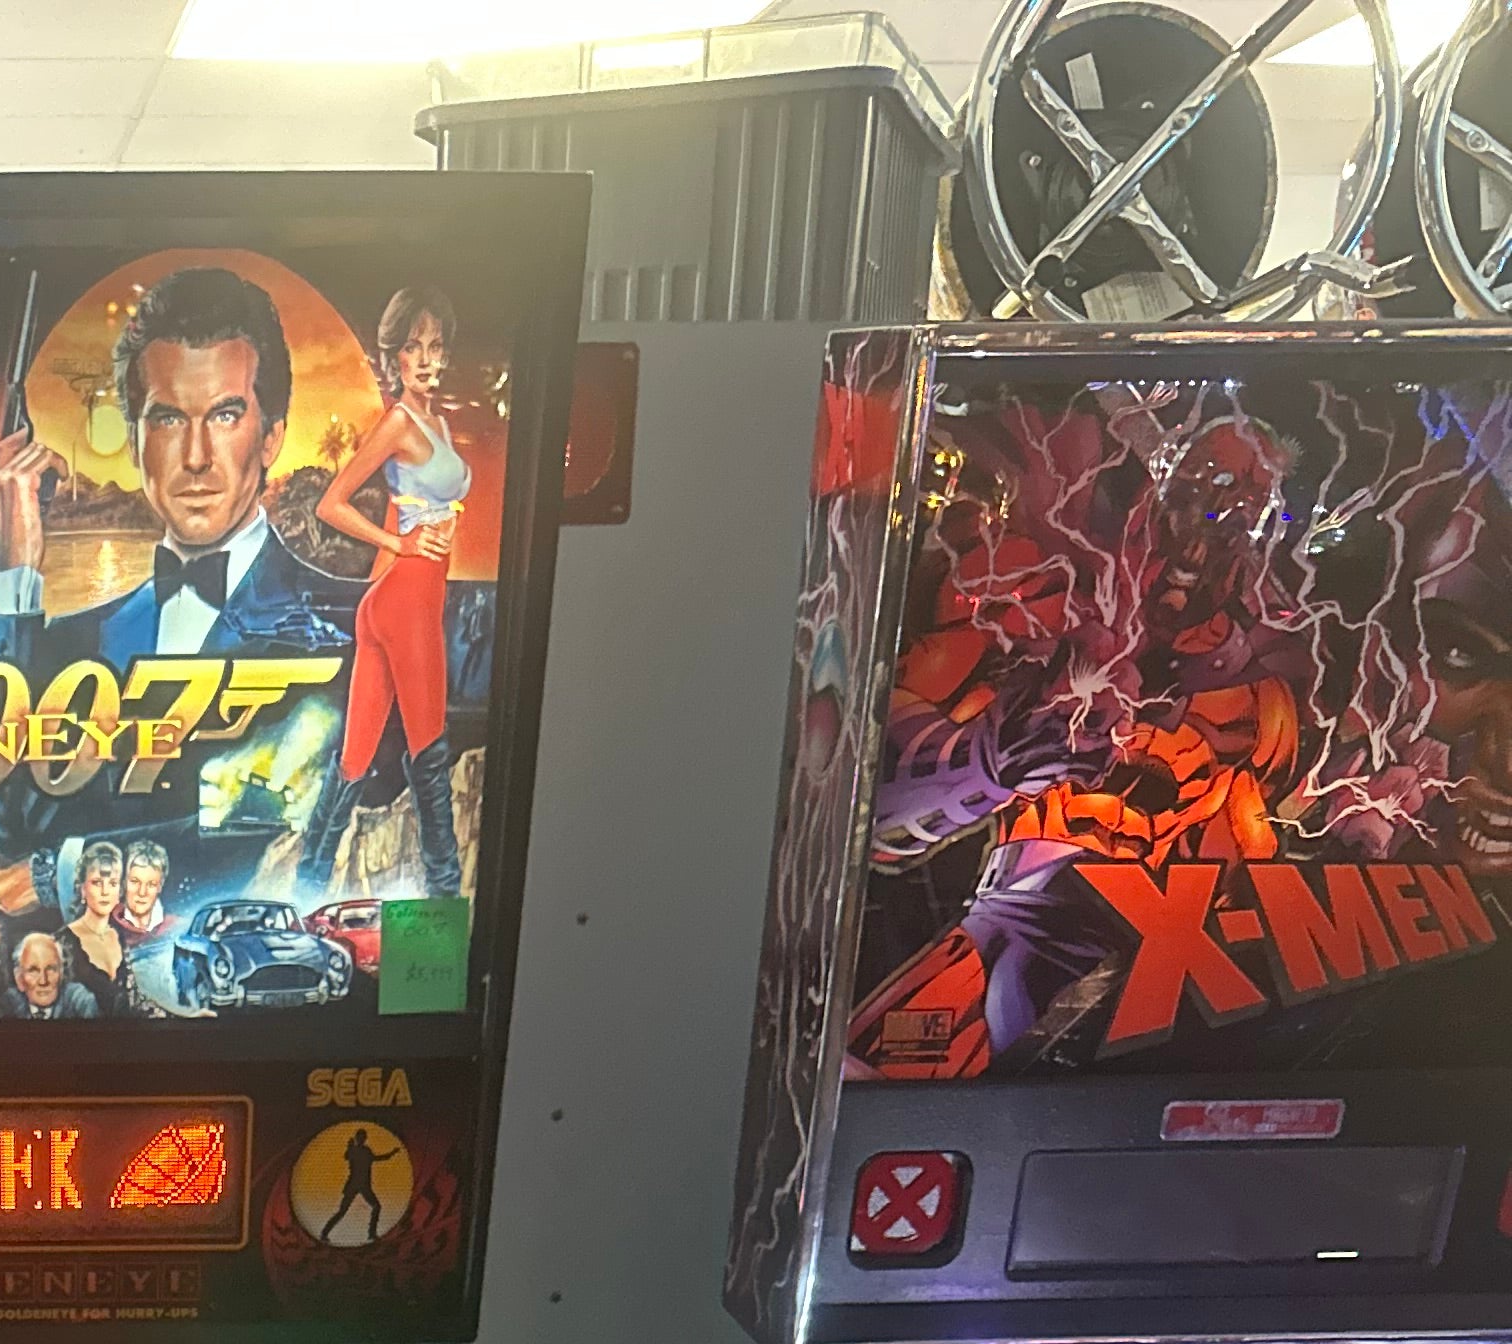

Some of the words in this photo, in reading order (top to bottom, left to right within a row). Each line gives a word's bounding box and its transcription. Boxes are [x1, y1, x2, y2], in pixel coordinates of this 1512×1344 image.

[1072, 864, 1497, 1045] X-MEN
[306, 1068, 412, 1108] SEGA
[82, 1308, 111, 1321] FOR
[115, 1307, 200, 1320] HURRY-UPS
